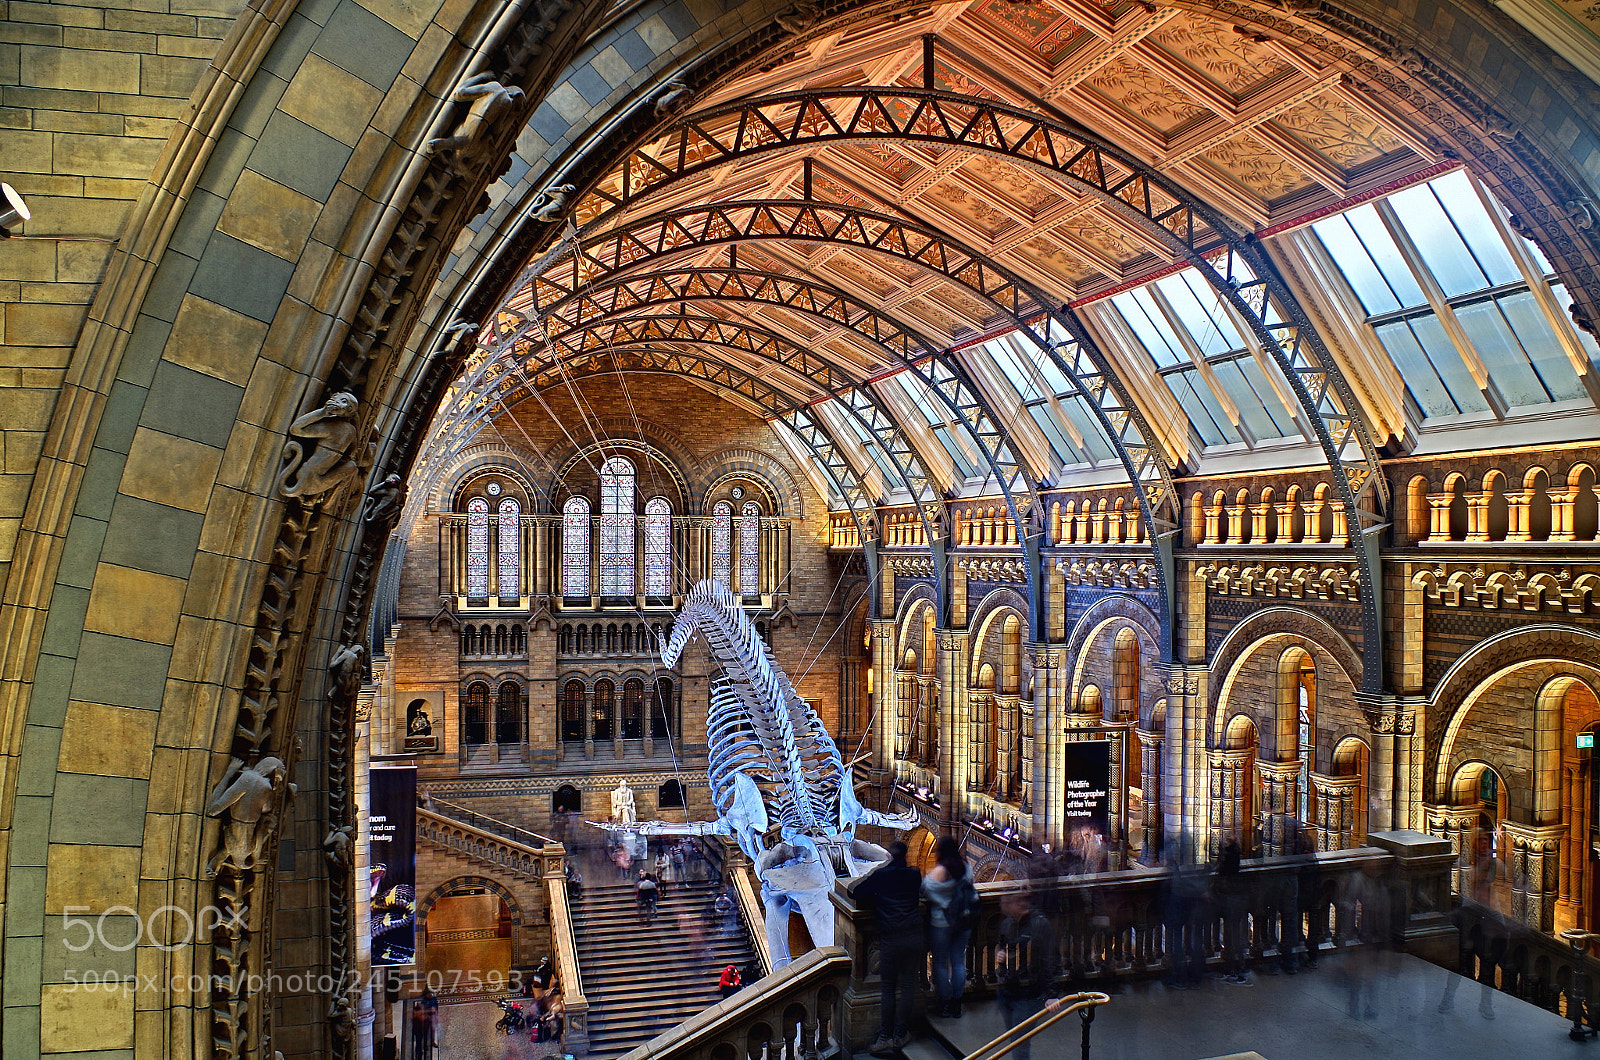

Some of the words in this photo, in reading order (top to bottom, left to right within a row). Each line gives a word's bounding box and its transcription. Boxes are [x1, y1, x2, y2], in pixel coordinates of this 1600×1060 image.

[1067, 780, 1090, 788] Wildlife
[1067, 789, 1106, 799] Photographer
[374, 834, 392, 842] today
